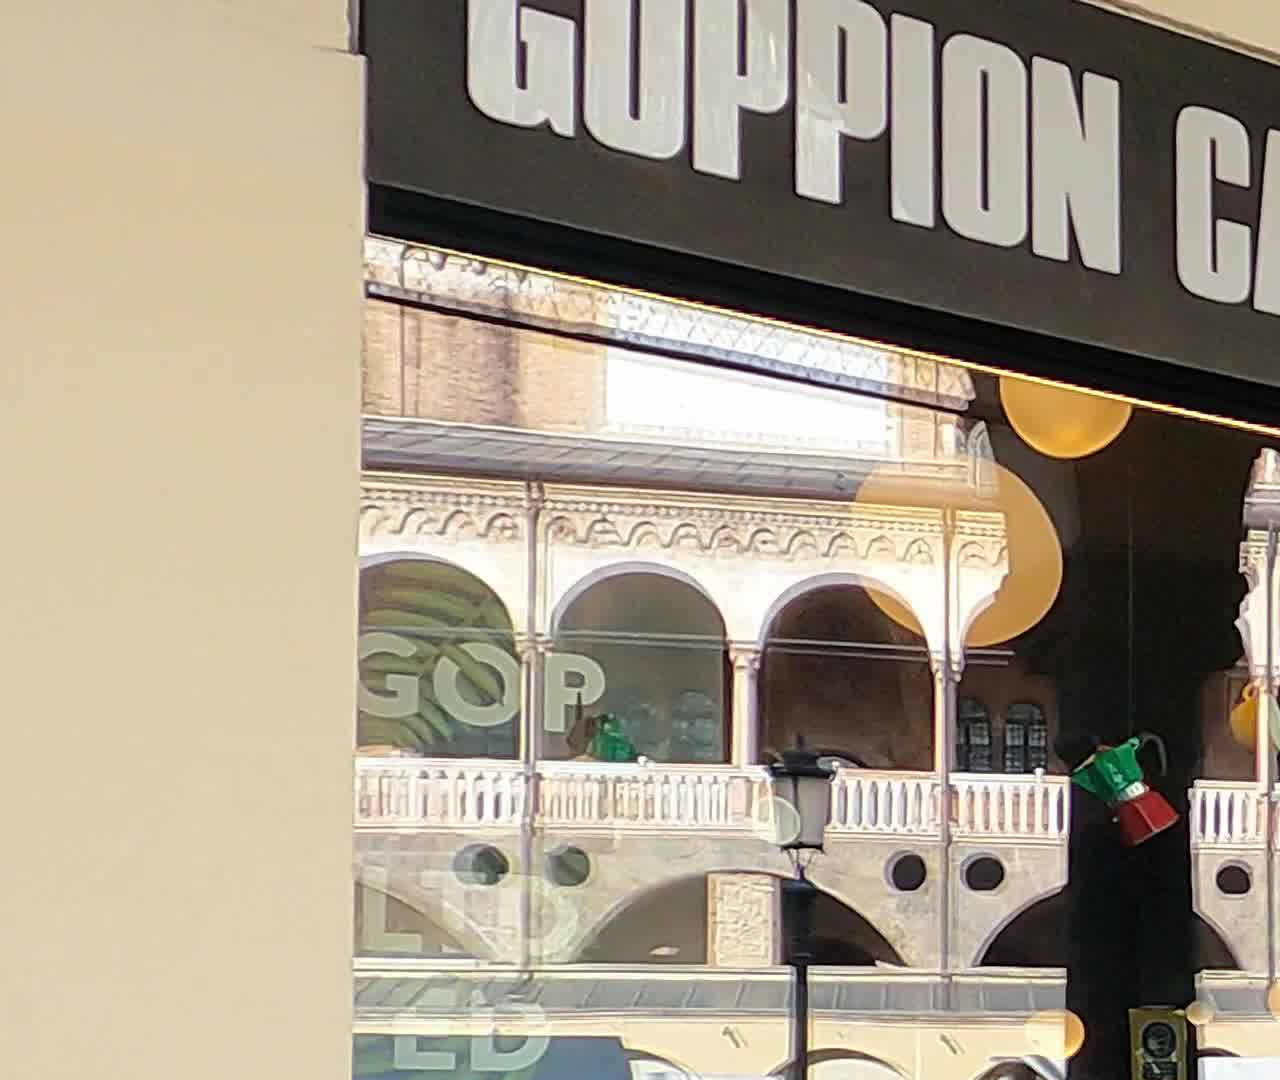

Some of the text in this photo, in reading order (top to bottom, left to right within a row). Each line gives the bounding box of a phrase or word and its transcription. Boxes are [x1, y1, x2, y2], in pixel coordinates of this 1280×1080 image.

[467, 0, 1122, 275] GOPPION
[359, 632, 606, 733] GOP
[394, 1000, 551, 1073] ED
